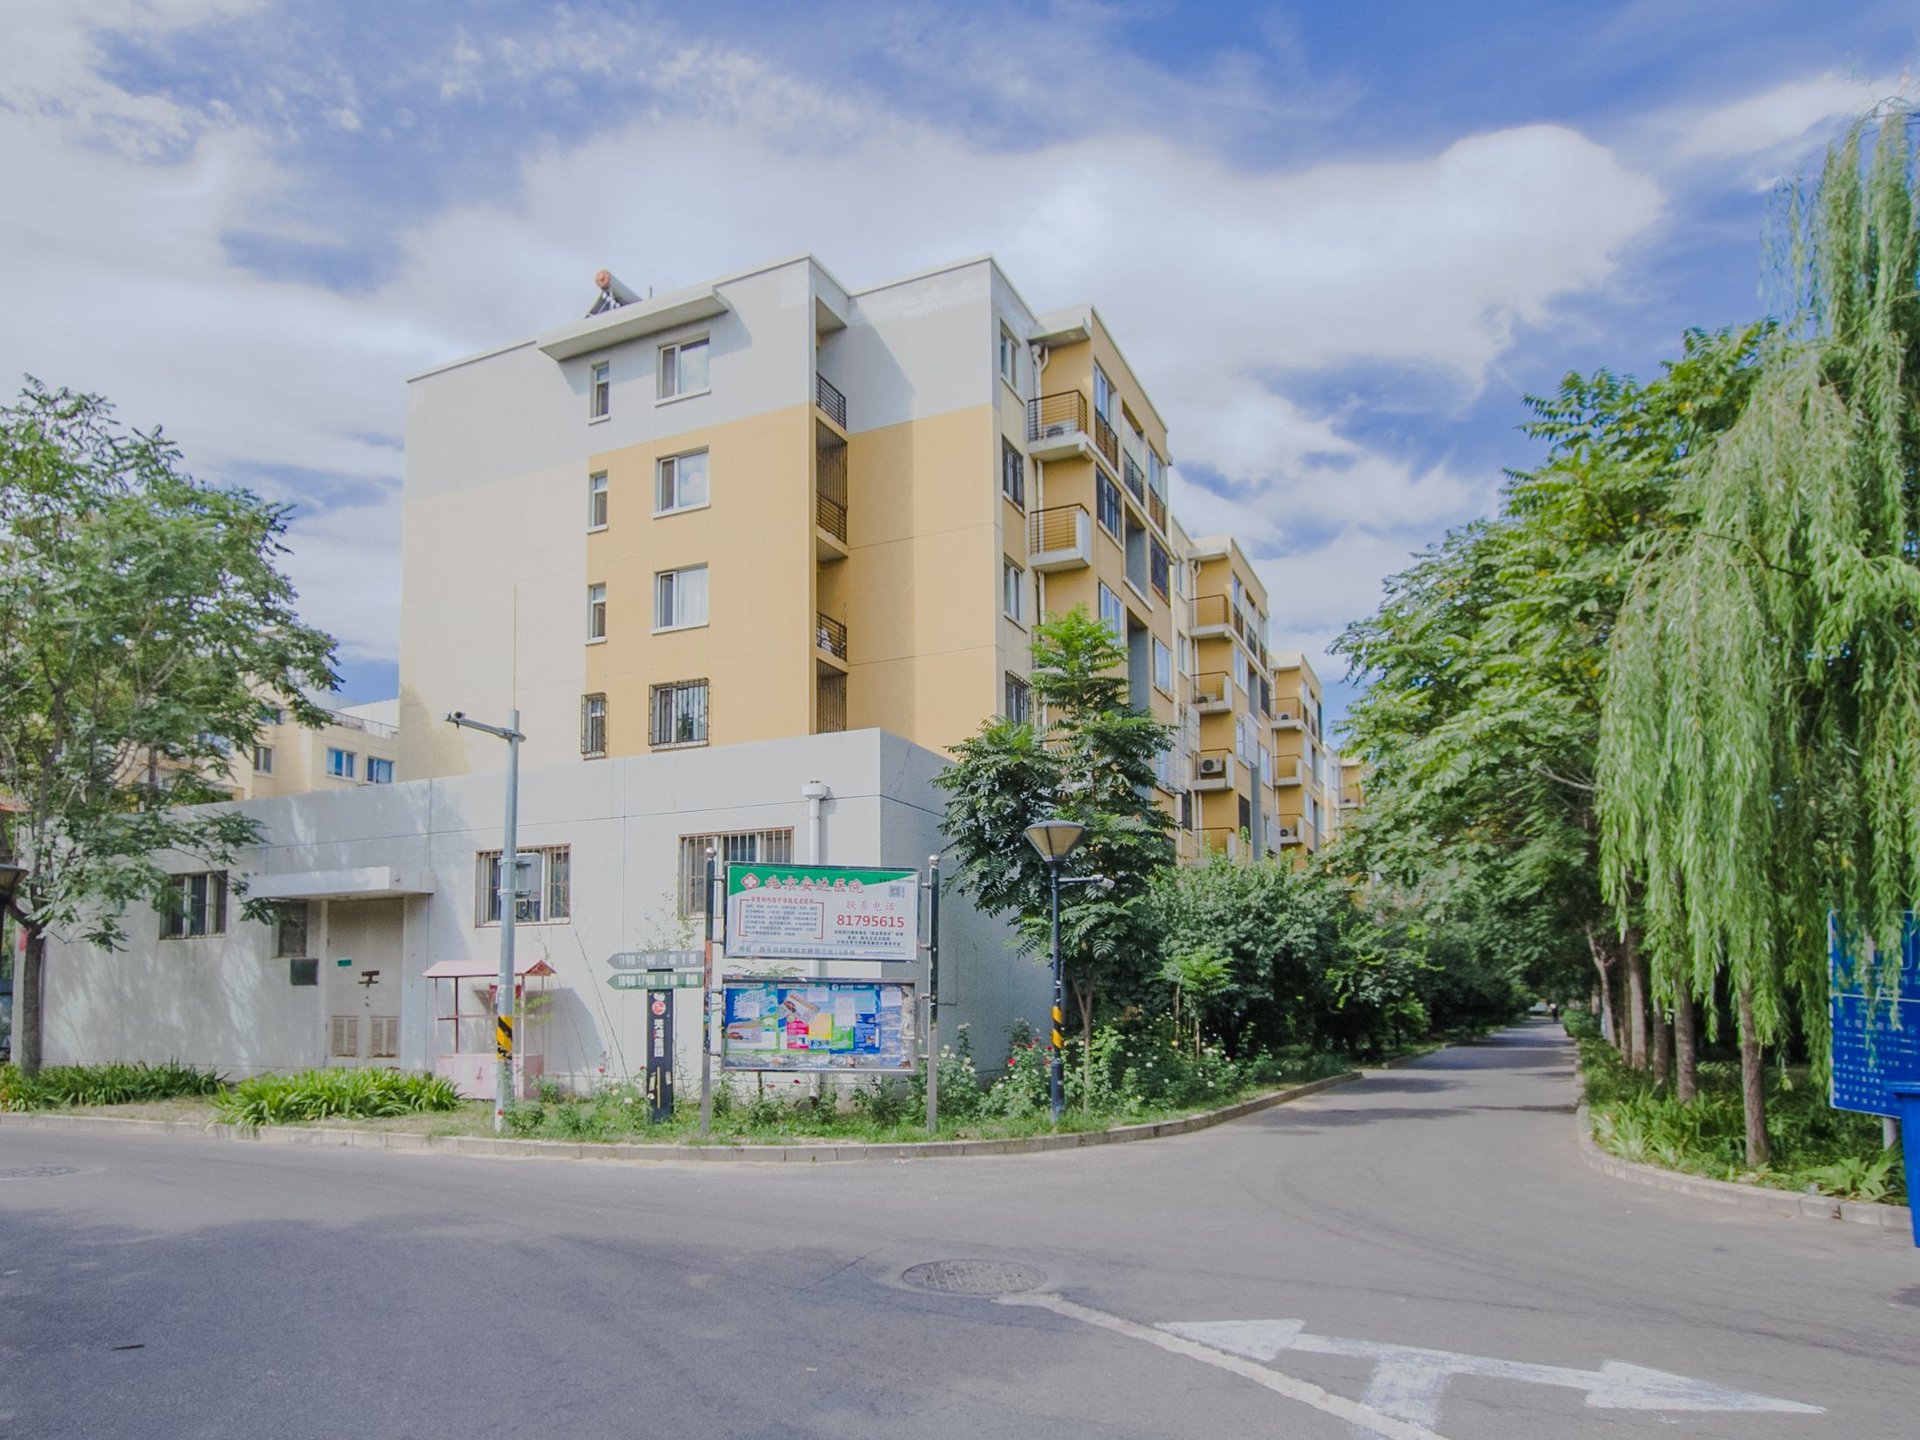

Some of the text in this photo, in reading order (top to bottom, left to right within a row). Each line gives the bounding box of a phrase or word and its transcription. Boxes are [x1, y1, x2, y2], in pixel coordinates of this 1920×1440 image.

[845, 900, 896, 911] 联系电话
[836, 914, 904, 928] 81795615
